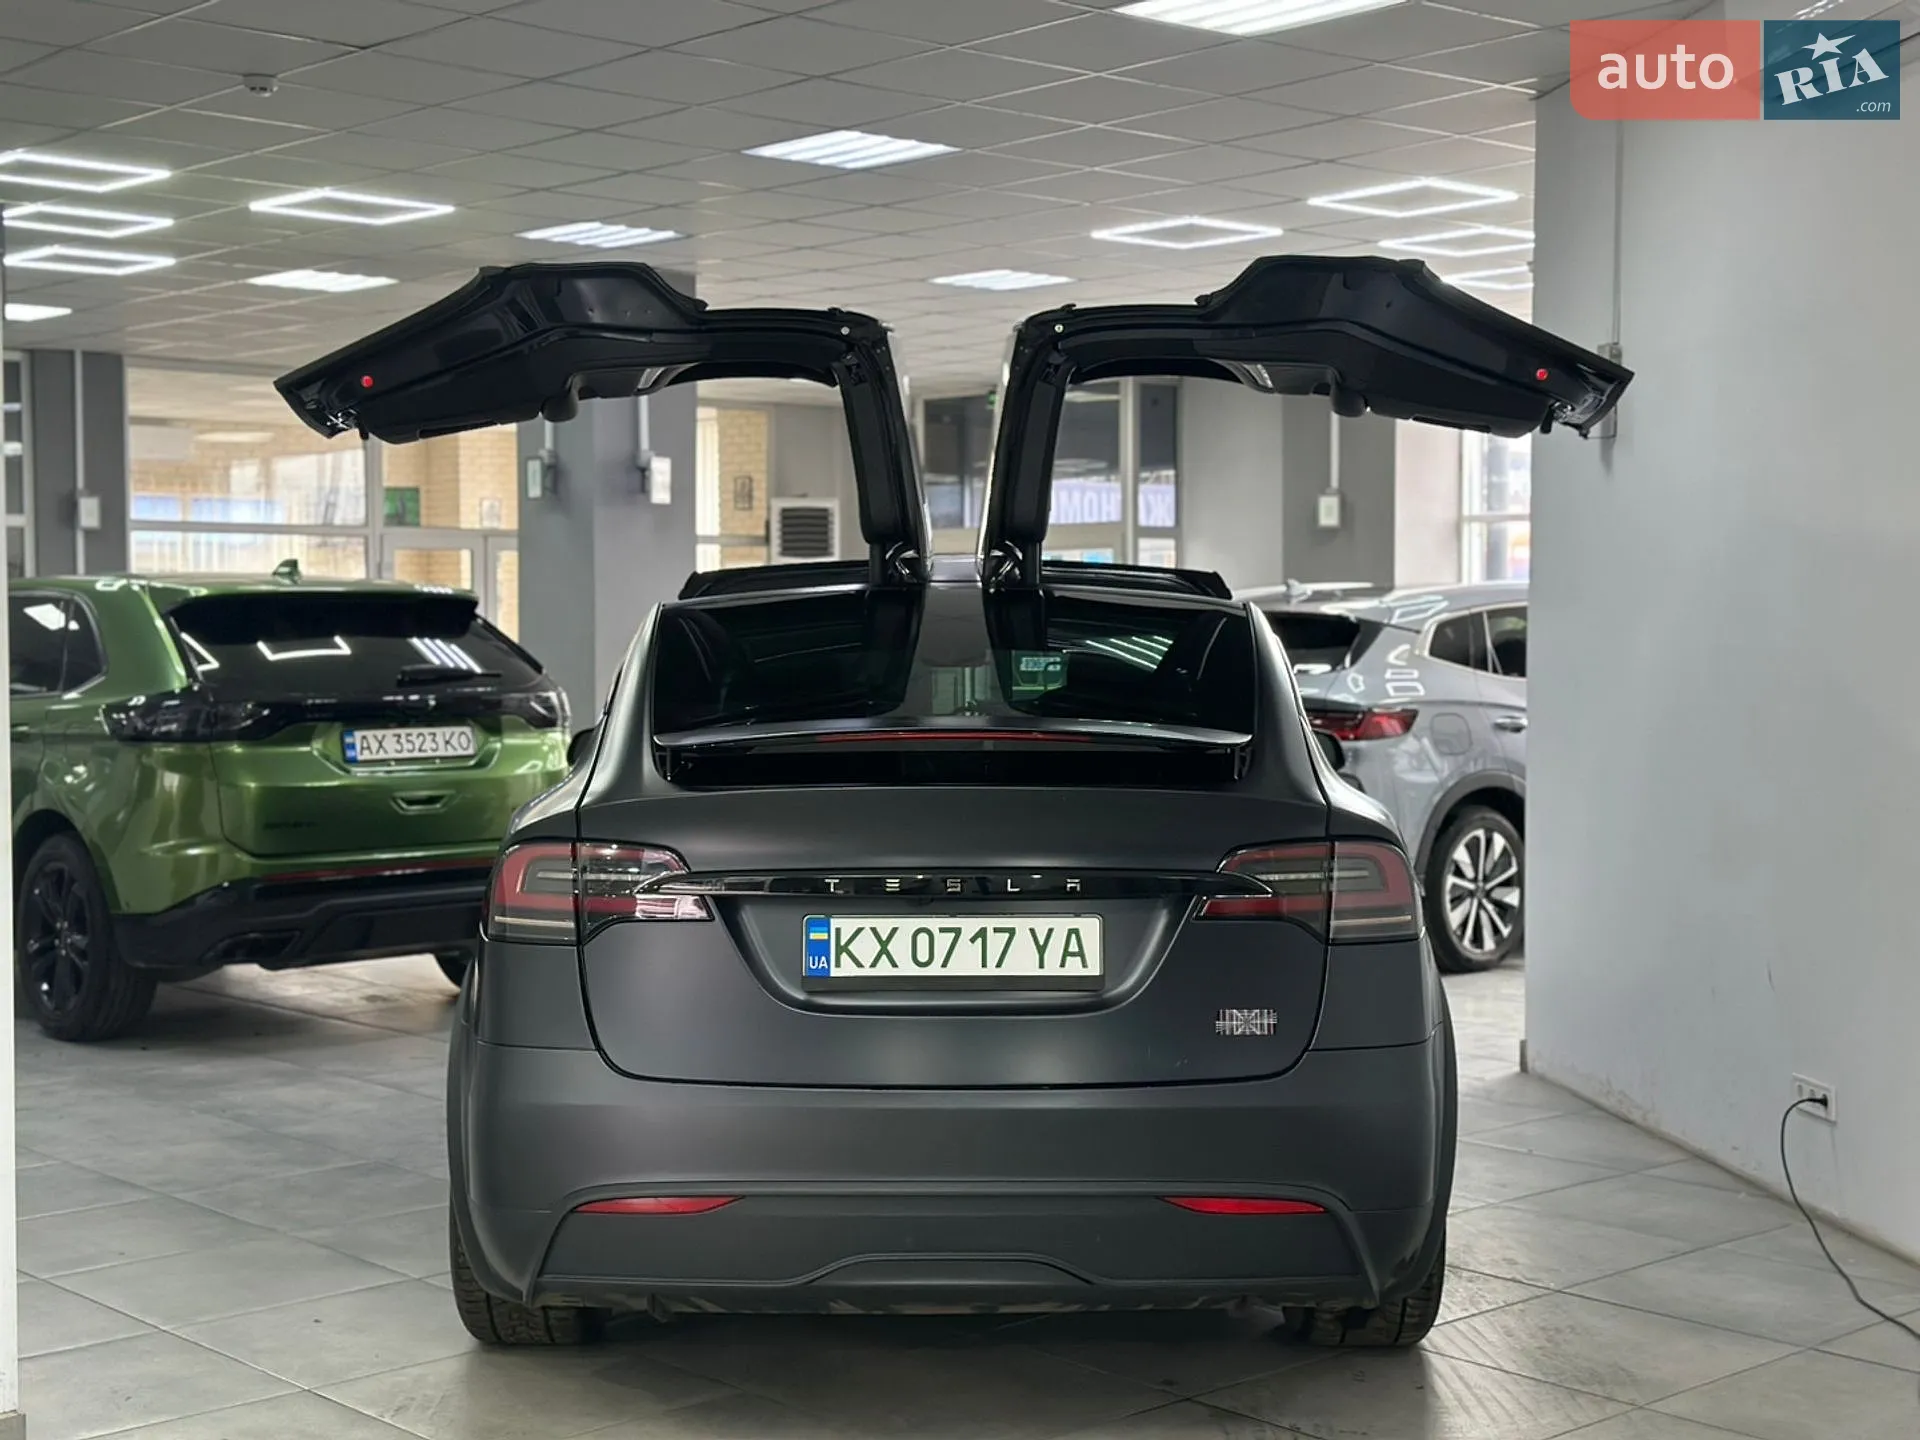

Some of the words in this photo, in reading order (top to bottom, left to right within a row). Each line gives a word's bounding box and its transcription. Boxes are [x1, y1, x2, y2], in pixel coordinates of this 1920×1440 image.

[359, 734, 388, 757] AX
[392, 732, 440, 753] 3523
[824, 878, 1081, 893] TESLA
[834, 926, 899, 969] KX
[911, 926, 1017, 969] 0717
[1028, 927, 1089, 969] YA
[809, 955, 829, 969] UA
